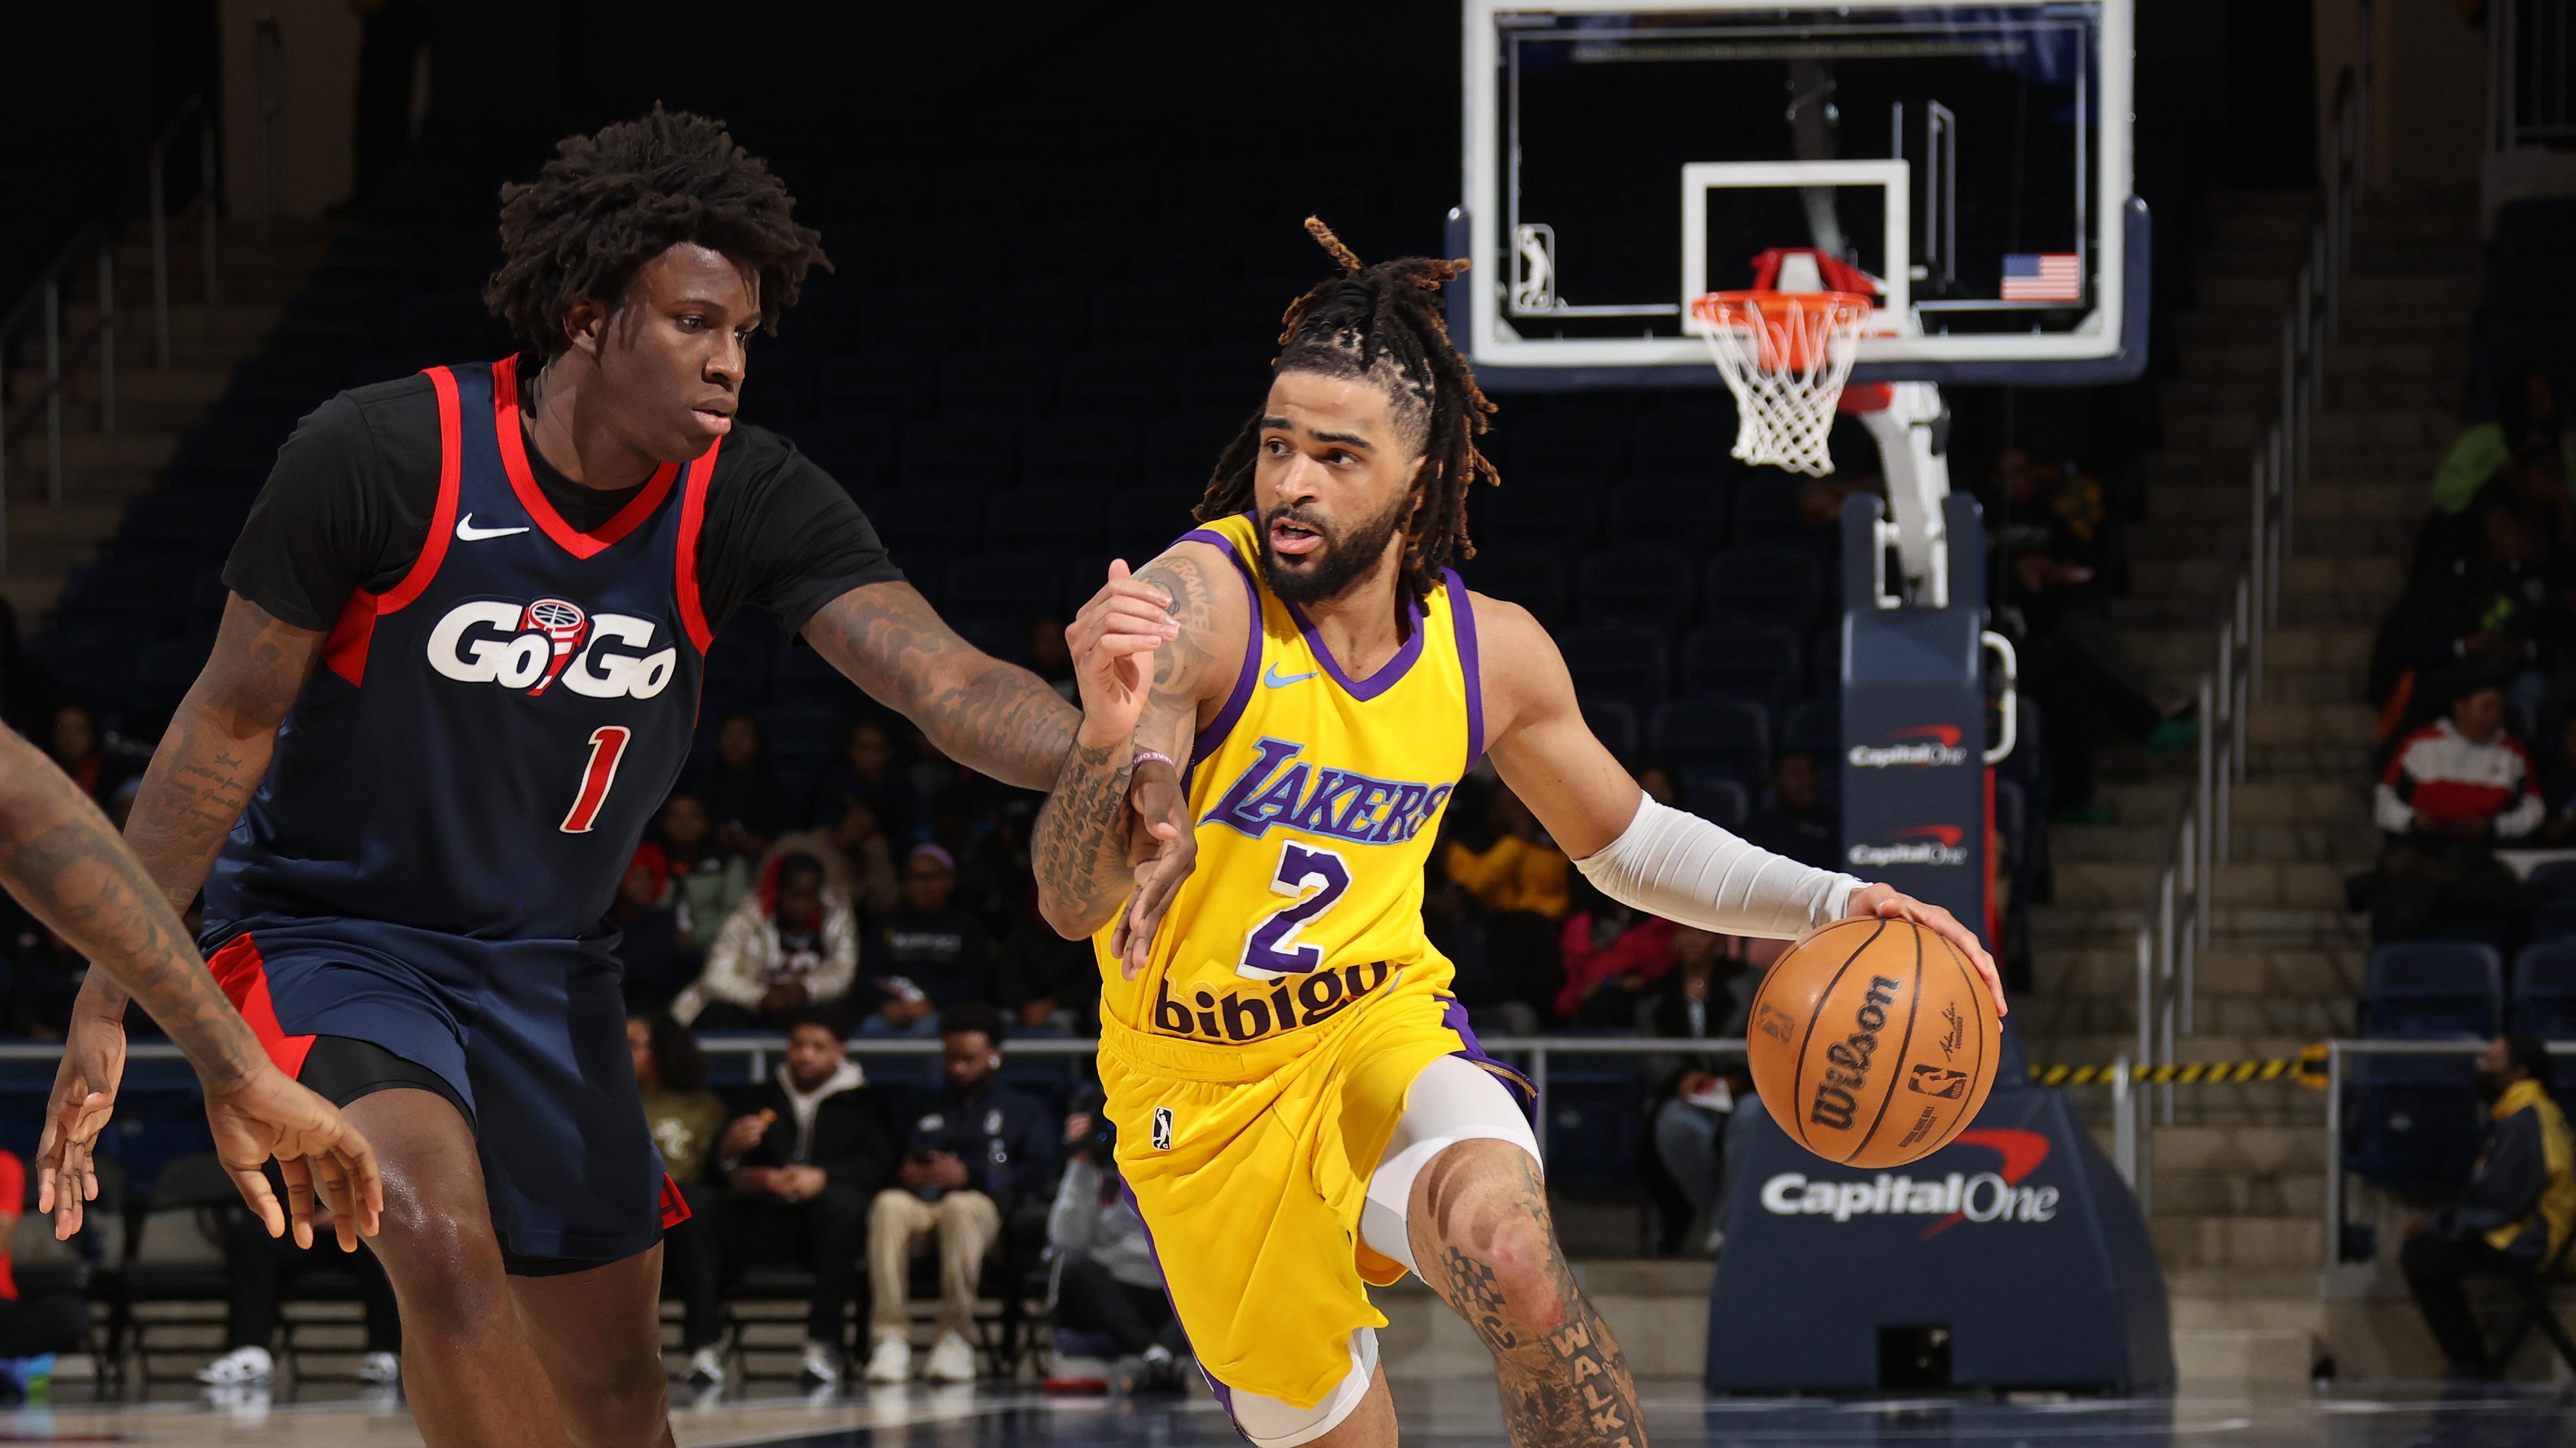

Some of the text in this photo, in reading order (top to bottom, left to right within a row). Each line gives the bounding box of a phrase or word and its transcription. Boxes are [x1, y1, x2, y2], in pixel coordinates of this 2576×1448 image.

[427, 601, 677, 699] Go Go
[559, 726, 631, 834] 1
[1197, 736, 1455, 846] LAKERS
[1236, 839, 1353, 980] 2
[1154, 960, 1388, 1041] bibigo
[1811, 974, 1902, 1131] Wilson
